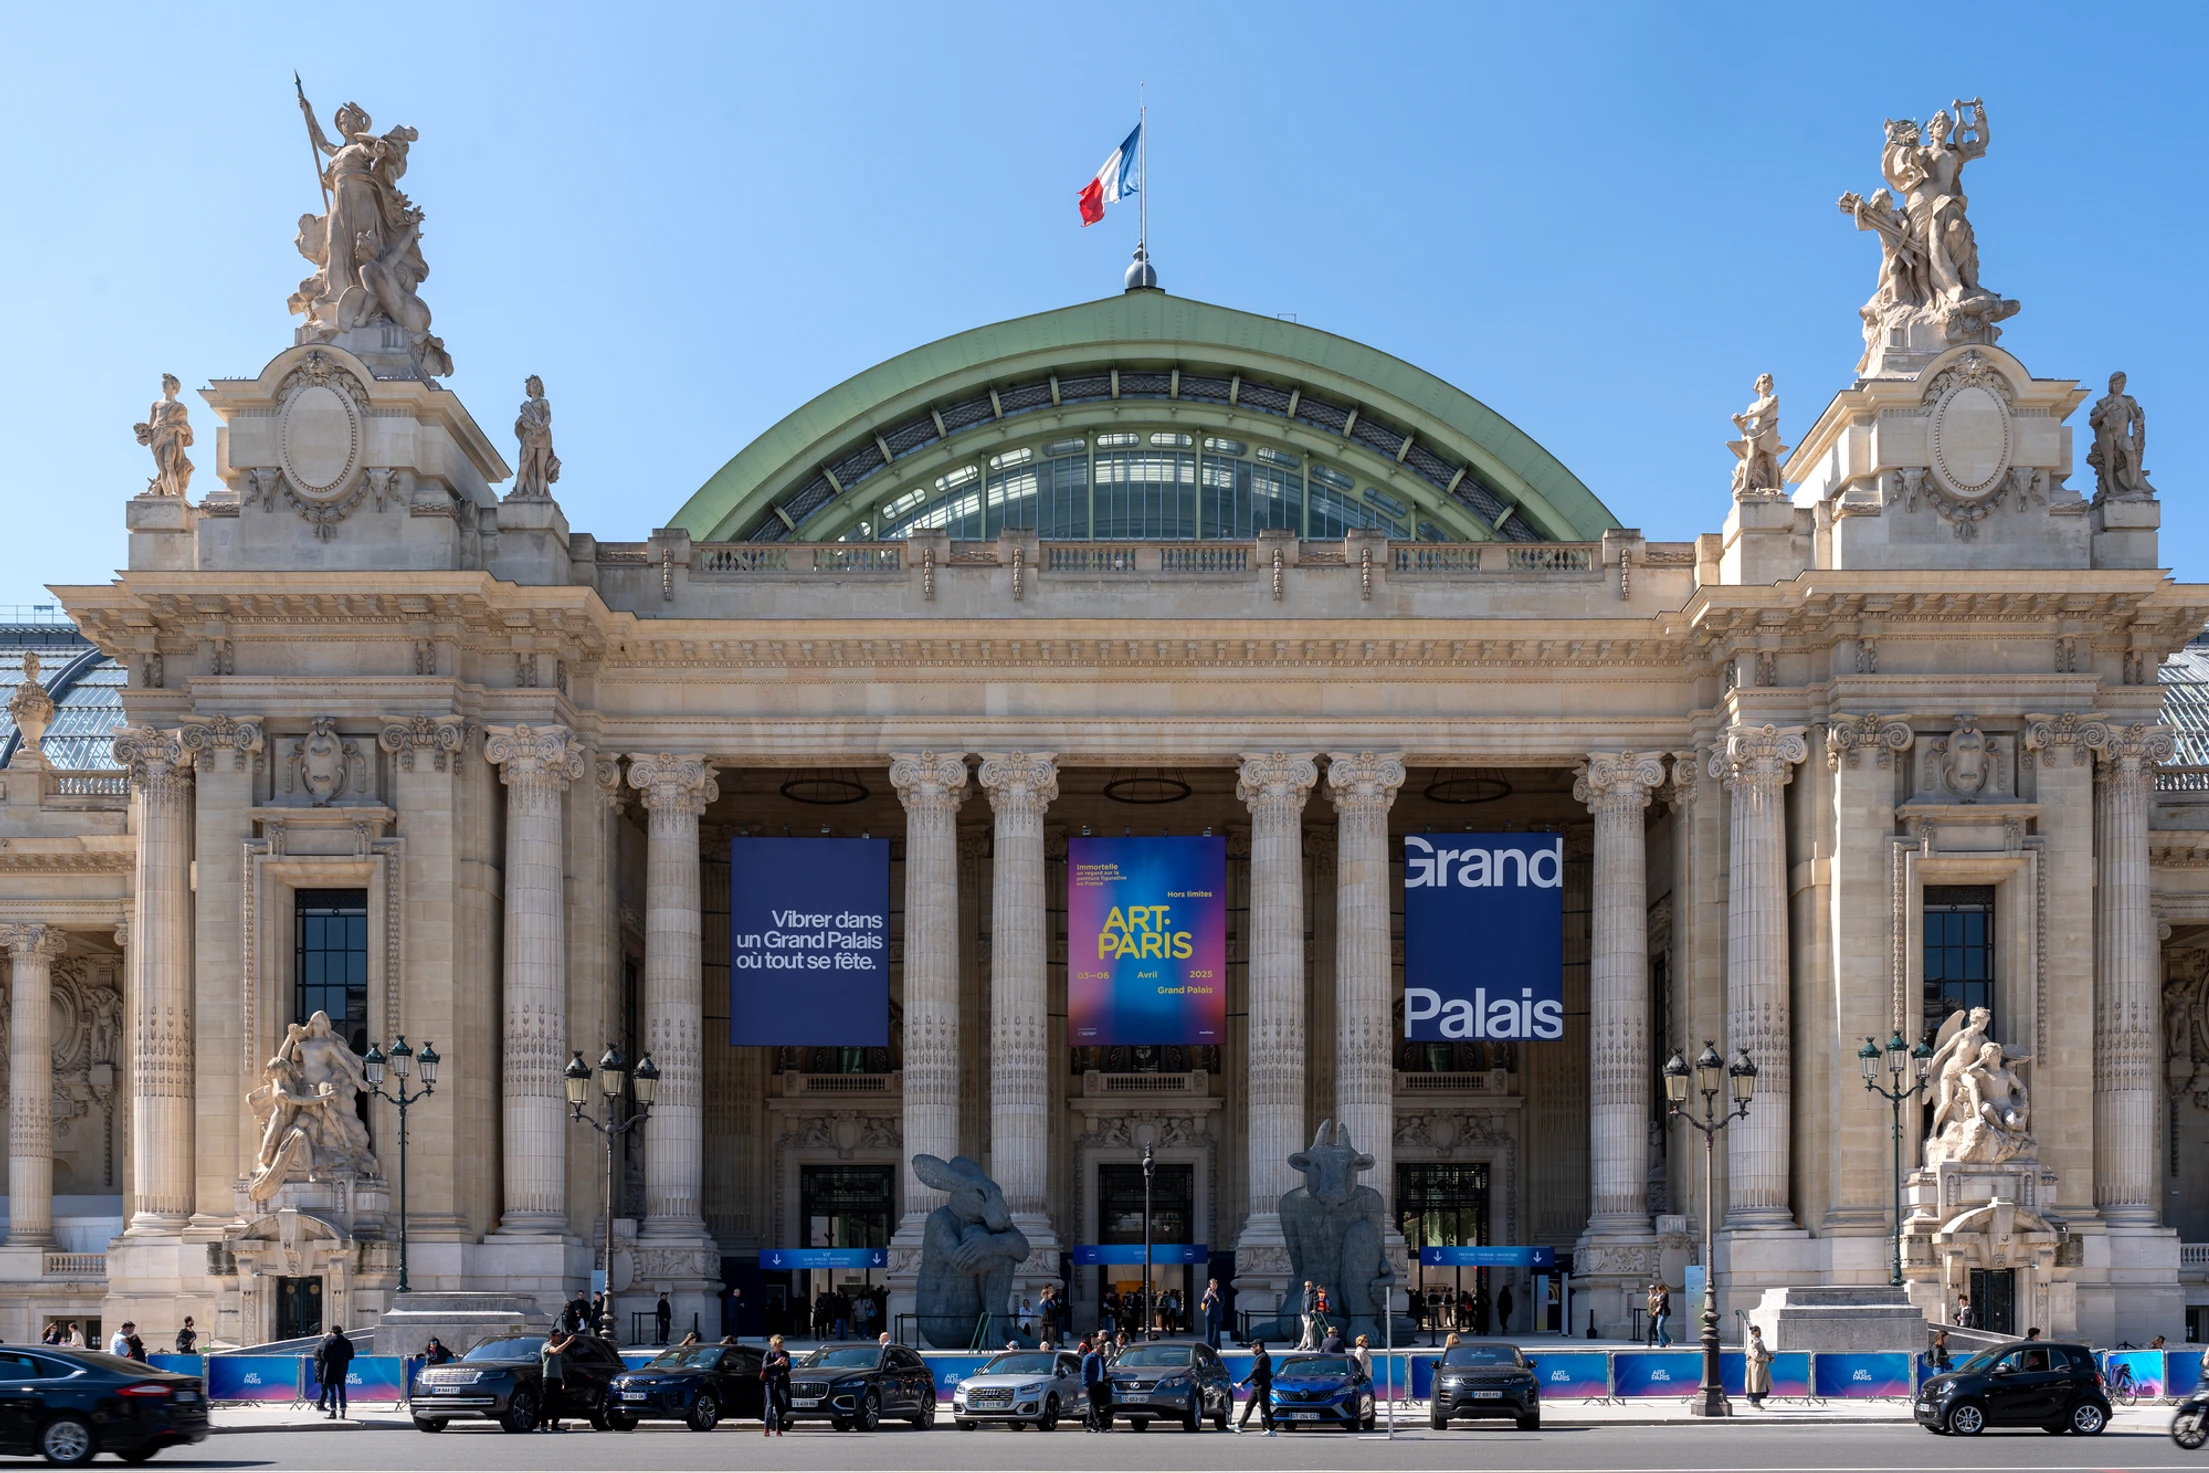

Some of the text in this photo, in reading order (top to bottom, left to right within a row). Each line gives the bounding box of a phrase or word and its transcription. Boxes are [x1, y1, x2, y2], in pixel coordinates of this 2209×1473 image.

[1405, 836, 1562, 888] Grand
[1187, 890, 1212, 898] limites
[772, 910, 882, 929] Vibrer dans
[736, 931, 882, 950] un Grand Palais
[1098, 932, 1193, 960] PARIS
[736, 951, 876, 970] où tout se fête.
[1137, 970, 1158, 979] Avril
[1190, 970, 1213, 978] 2025
[1158, 986, 1213, 995] Grand Palais
[1405, 987, 1562, 1039] Palais
